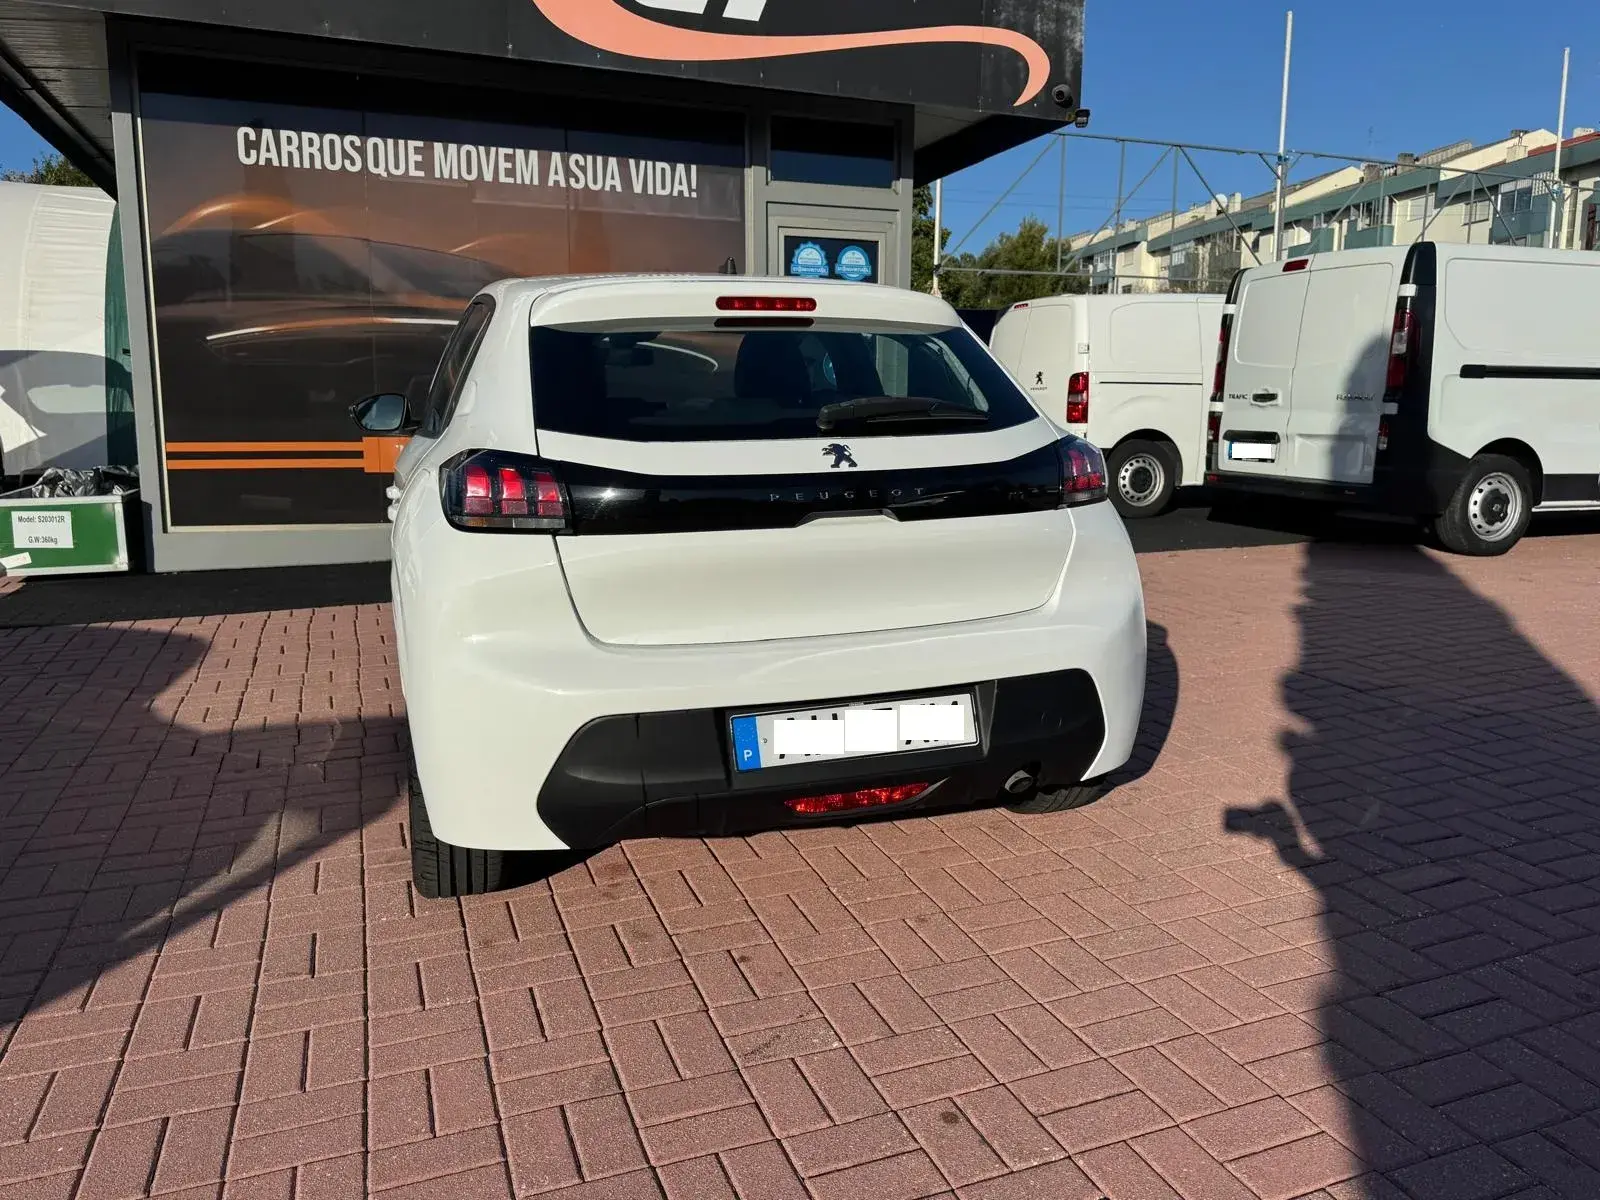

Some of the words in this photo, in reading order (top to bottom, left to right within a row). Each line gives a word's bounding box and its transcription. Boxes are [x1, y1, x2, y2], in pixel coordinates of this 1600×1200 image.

[236, 126, 362, 173] CARROS
[366, 137, 425, 178] QUE
[433, 142, 539, 186] MOVEM
[547, 151, 567, 188] A
[568, 153, 623, 193] SUA
[628, 158, 698, 199] VIDA!
[769, 487, 925, 502] PEUGEOT
[17, 515, 36, 523] Model:
[743, 749, 753, 761] P
